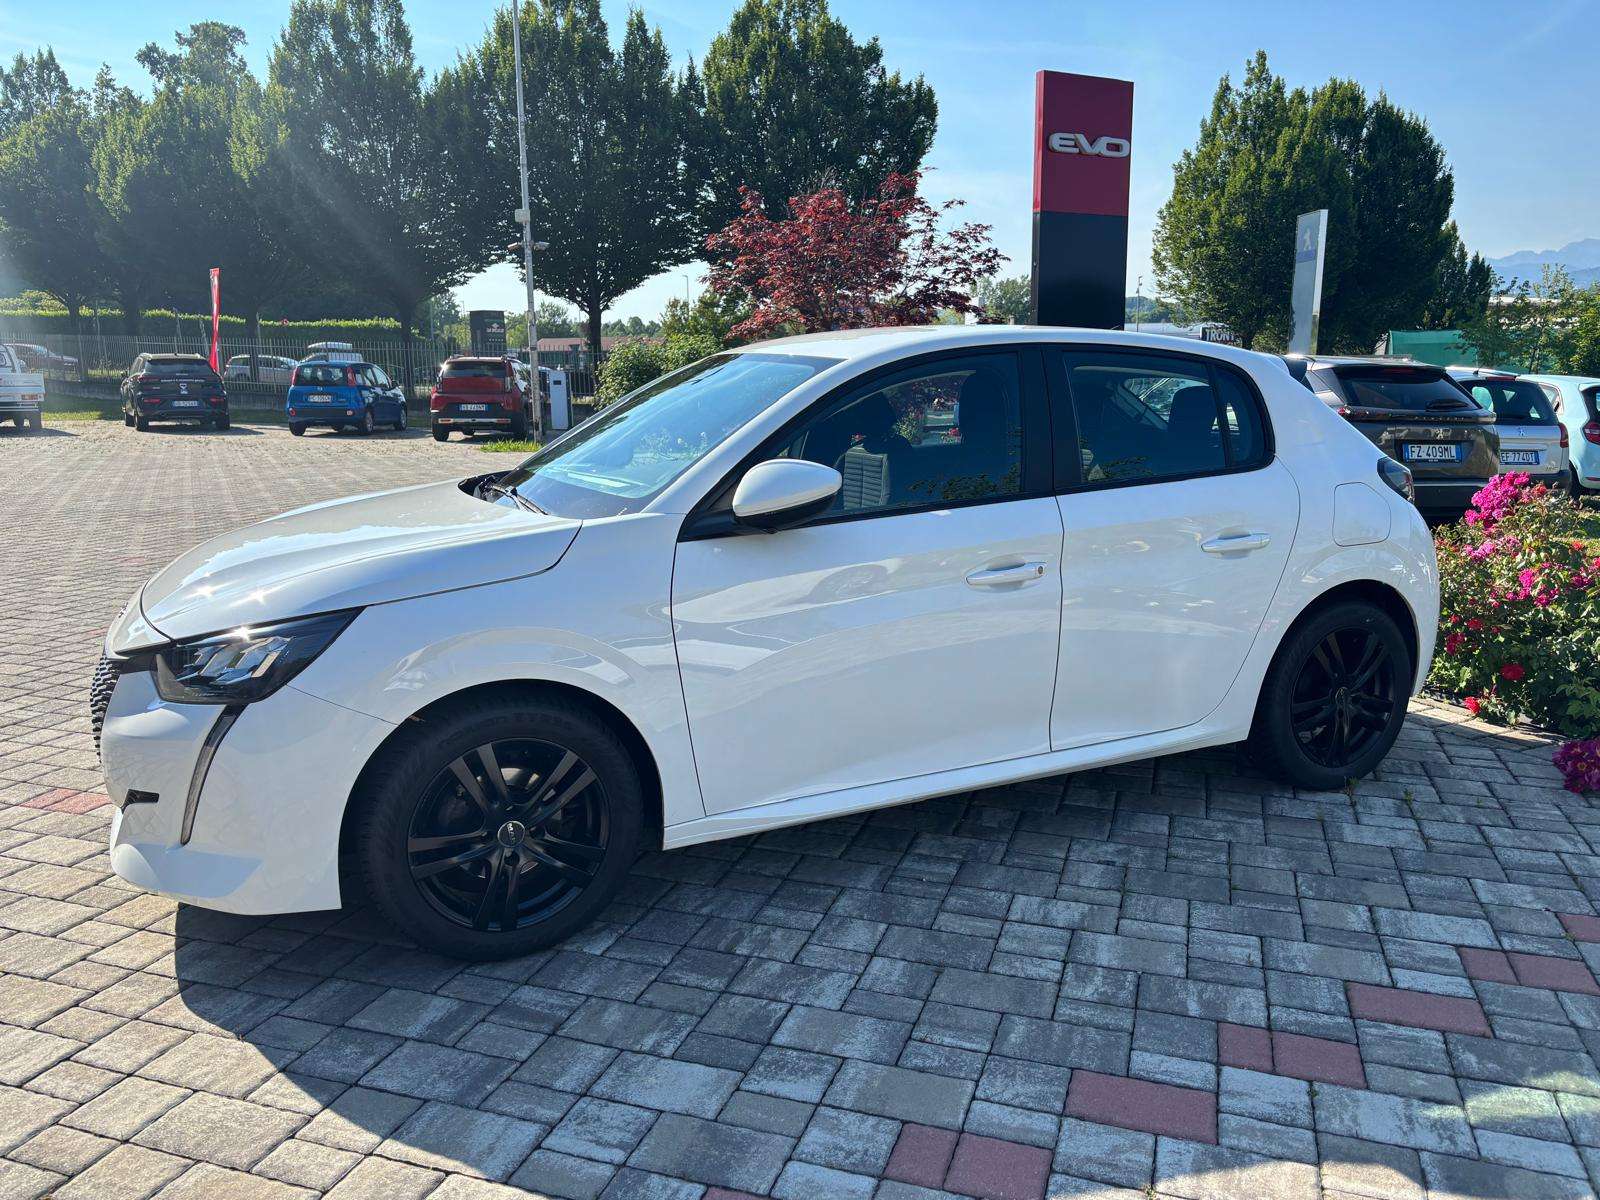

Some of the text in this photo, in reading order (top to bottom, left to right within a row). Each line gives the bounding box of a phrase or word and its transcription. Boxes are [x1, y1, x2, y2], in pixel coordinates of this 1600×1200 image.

[1049, 132, 1130, 157] EVO
[1409, 445, 1456, 458] FZ 409ML
